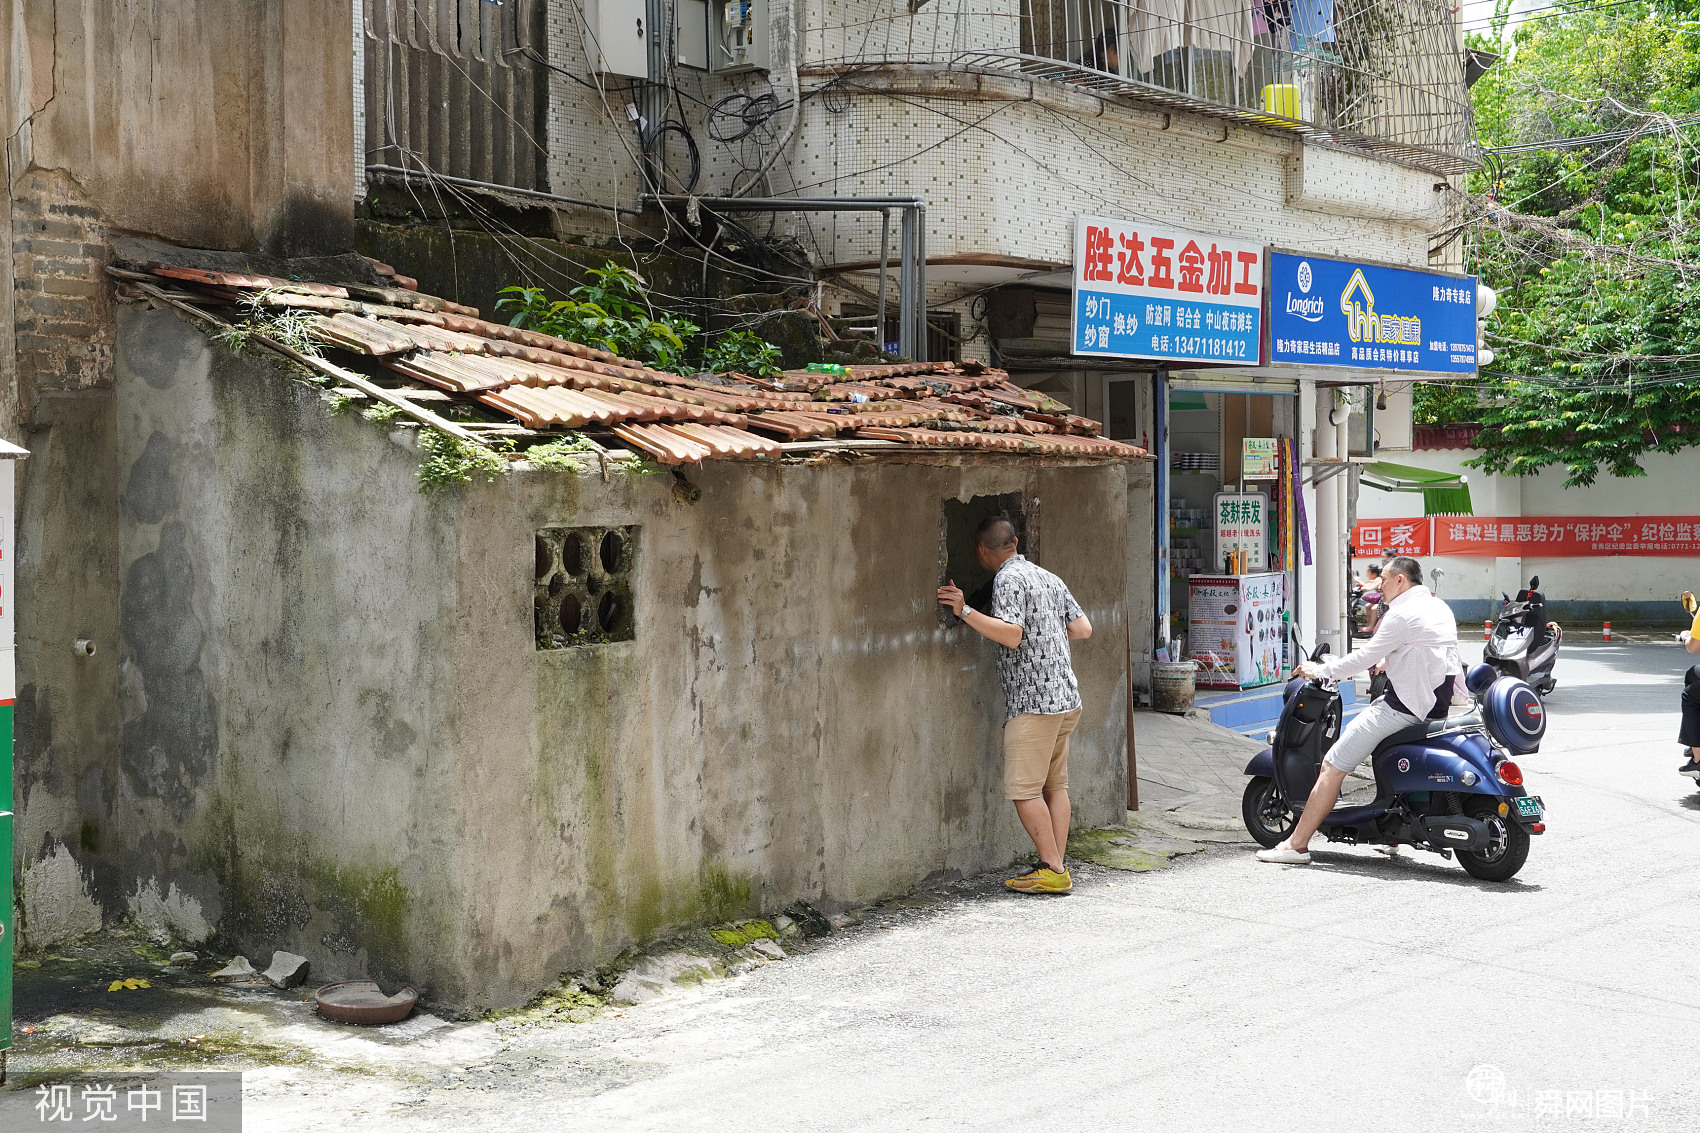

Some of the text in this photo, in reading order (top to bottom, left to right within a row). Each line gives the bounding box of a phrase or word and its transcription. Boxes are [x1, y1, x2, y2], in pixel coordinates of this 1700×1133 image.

[1083, 225, 1258, 296] 胜达五金加工
[1085, 295, 1111, 320] 纱门
[1286, 291, 1324, 316] Longrich
[1432, 286, 1471, 305] 隆力奇专卖店
[1113, 312, 1138, 336] 换纱
[1145, 303, 1171, 327] 防盗网
[1176, 306, 1201, 329] 铝合金
[1084, 324, 1110, 349] 纱窗
[1276, 339, 1340, 356] 隆力奇家居生活精品店
[1351, 347, 1419, 364] 高品质会员特价尊享店
[1359, 523, 1415, 546] 回家
